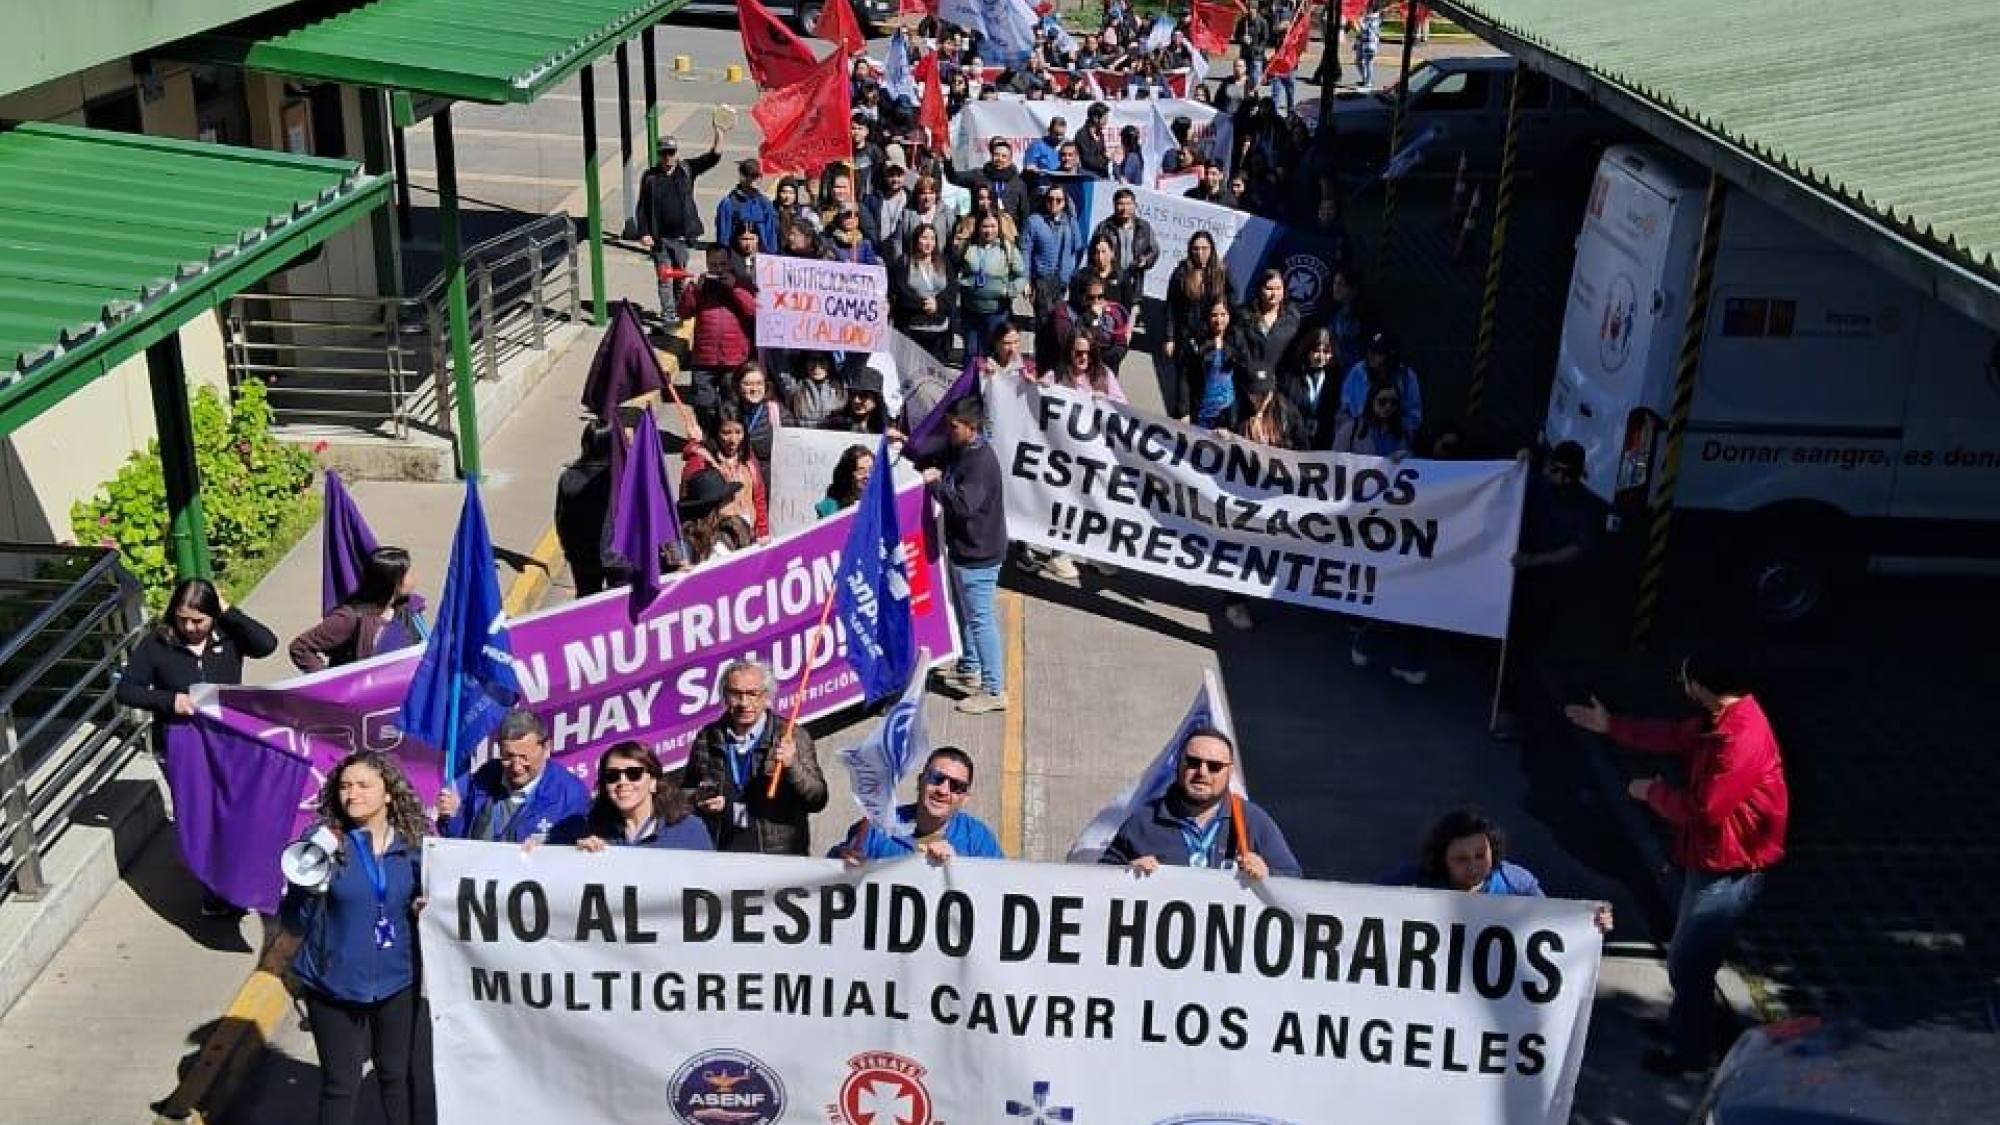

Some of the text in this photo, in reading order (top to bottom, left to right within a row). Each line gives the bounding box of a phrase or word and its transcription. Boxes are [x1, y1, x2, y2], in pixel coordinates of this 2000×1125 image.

[824, 295, 878, 322] CAMAS
[1012, 443, 1437, 559] ESTERILIZACIÓN
[1039, 395, 1420, 505] FUNCIONARIOS
[1702, 440, 1781, 463] Donar
[1902, 448, 1935, 466] es
[1050, 502, 1376, 605] !!PRESENTE!!
[564, 550, 840, 692] NUTRICIÓN
[552, 681, 662, 752] HAY
[456, 877, 1565, 1004] NO AL DESPIDO DE HONORARIOS
[471, 967, 1547, 1076] MULTIGREMIAL CAVRR LOS ANGELES
[688, 1093, 767, 1107] ASENF
